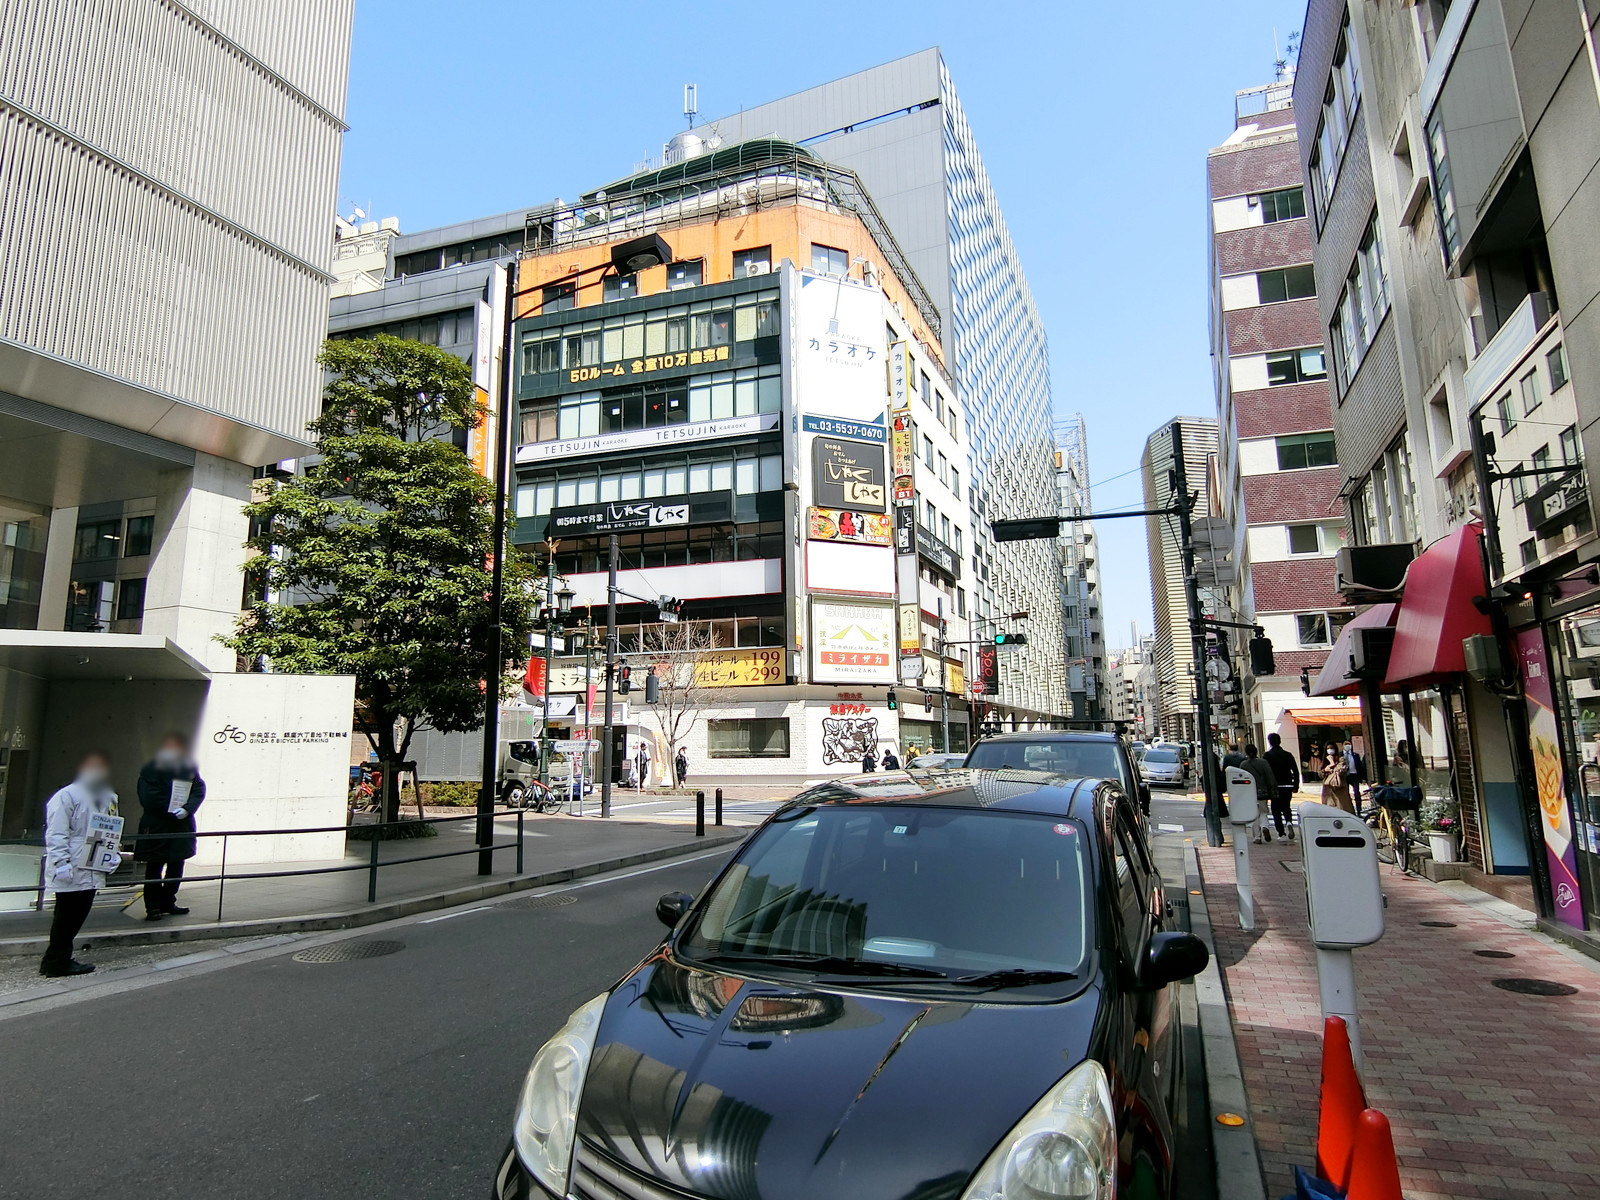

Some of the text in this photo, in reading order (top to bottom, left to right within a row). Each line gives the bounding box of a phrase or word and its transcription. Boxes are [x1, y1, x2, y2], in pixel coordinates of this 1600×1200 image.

[809, 338, 876, 360] カラオケ
[570, 364, 625, 383] 50ルーム
[895, 353, 903, 399] カラオケ
[656, 425, 717, 441] TETSUJIN
[545, 440, 600, 455] TETSUJIN
[852, 481, 880, 500] しゃく
[655, 505, 685, 523] しゃく
[829, 653, 882, 664] ミライザカ
[539, 659, 547, 687] TOKYO
[701, 670, 740, 682] 生ビール
[93, 815, 111, 824] GINZA
[106, 840, 115, 850] 右
[101, 853, 112, 866] P
